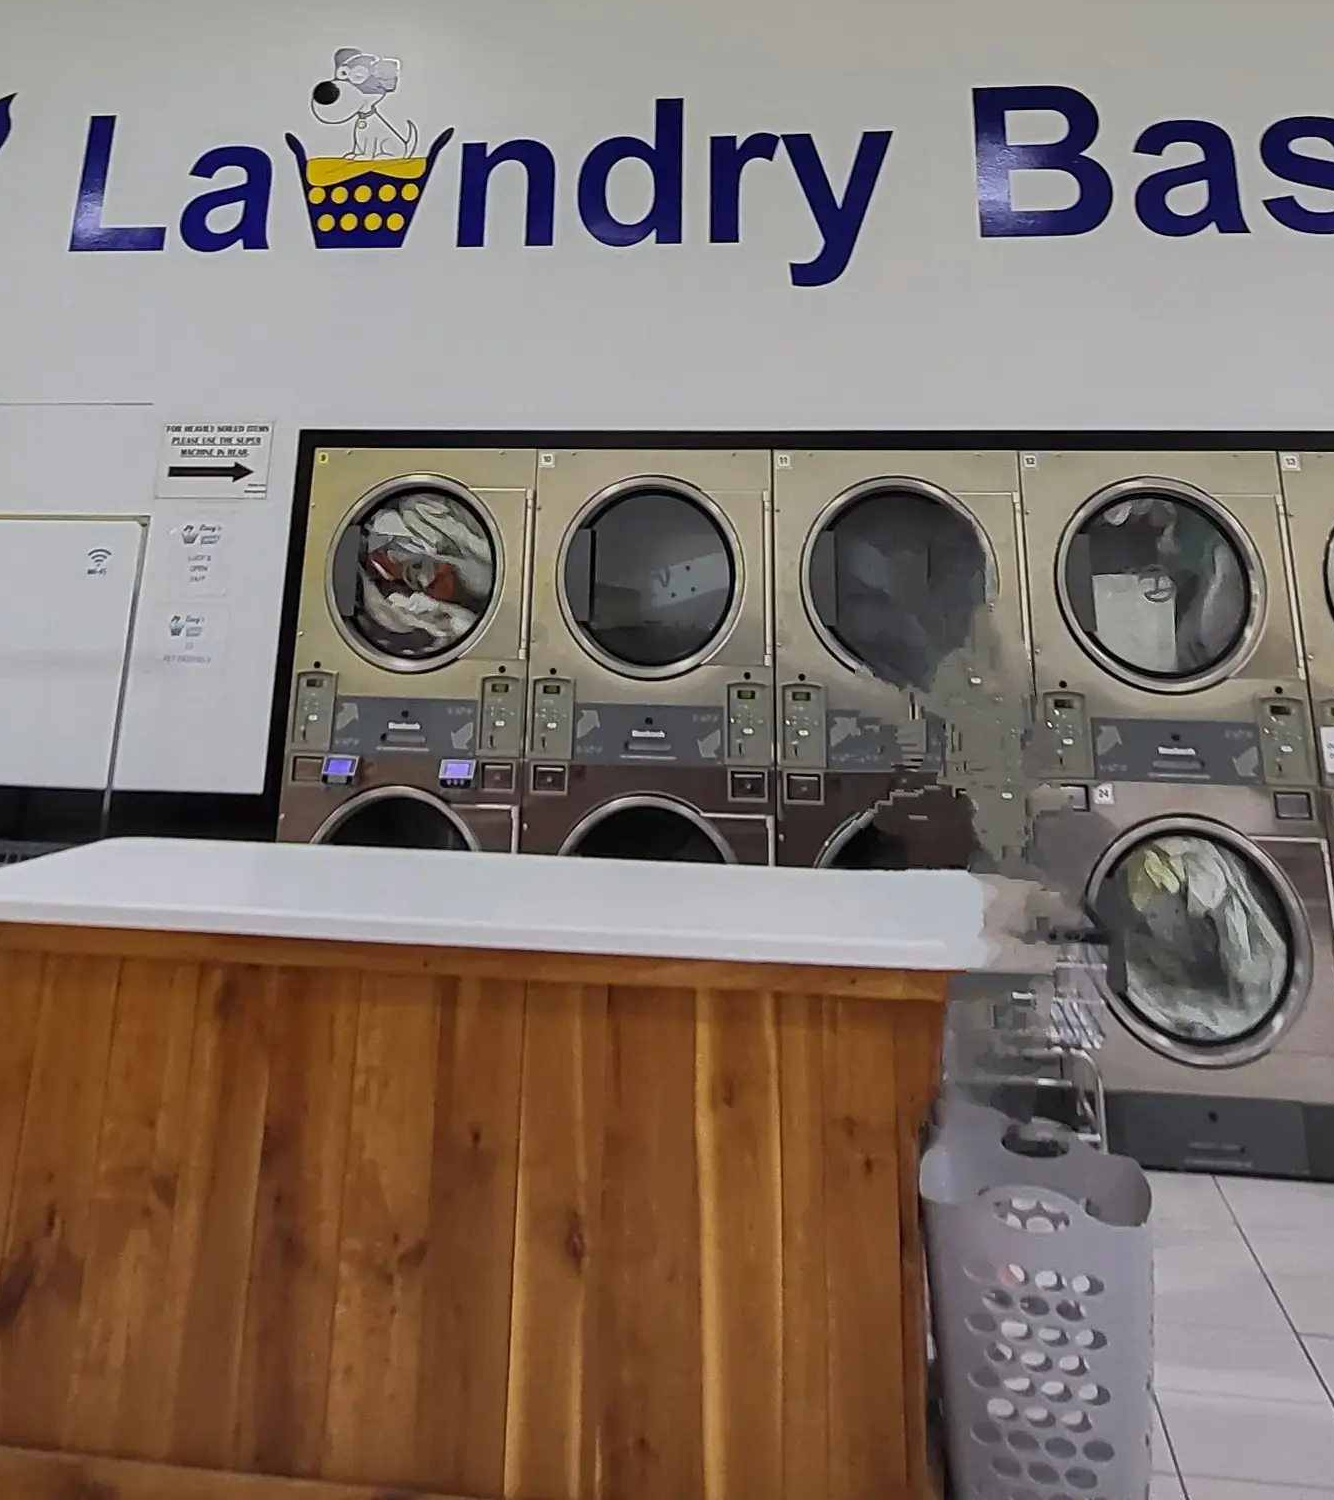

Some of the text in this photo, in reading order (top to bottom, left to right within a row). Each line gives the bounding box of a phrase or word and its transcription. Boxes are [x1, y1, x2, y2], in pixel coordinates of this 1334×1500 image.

[166, 425, 182, 433] FOR
[171, 437, 200, 445] PLEASE
[220, 437, 234, 445] THE
